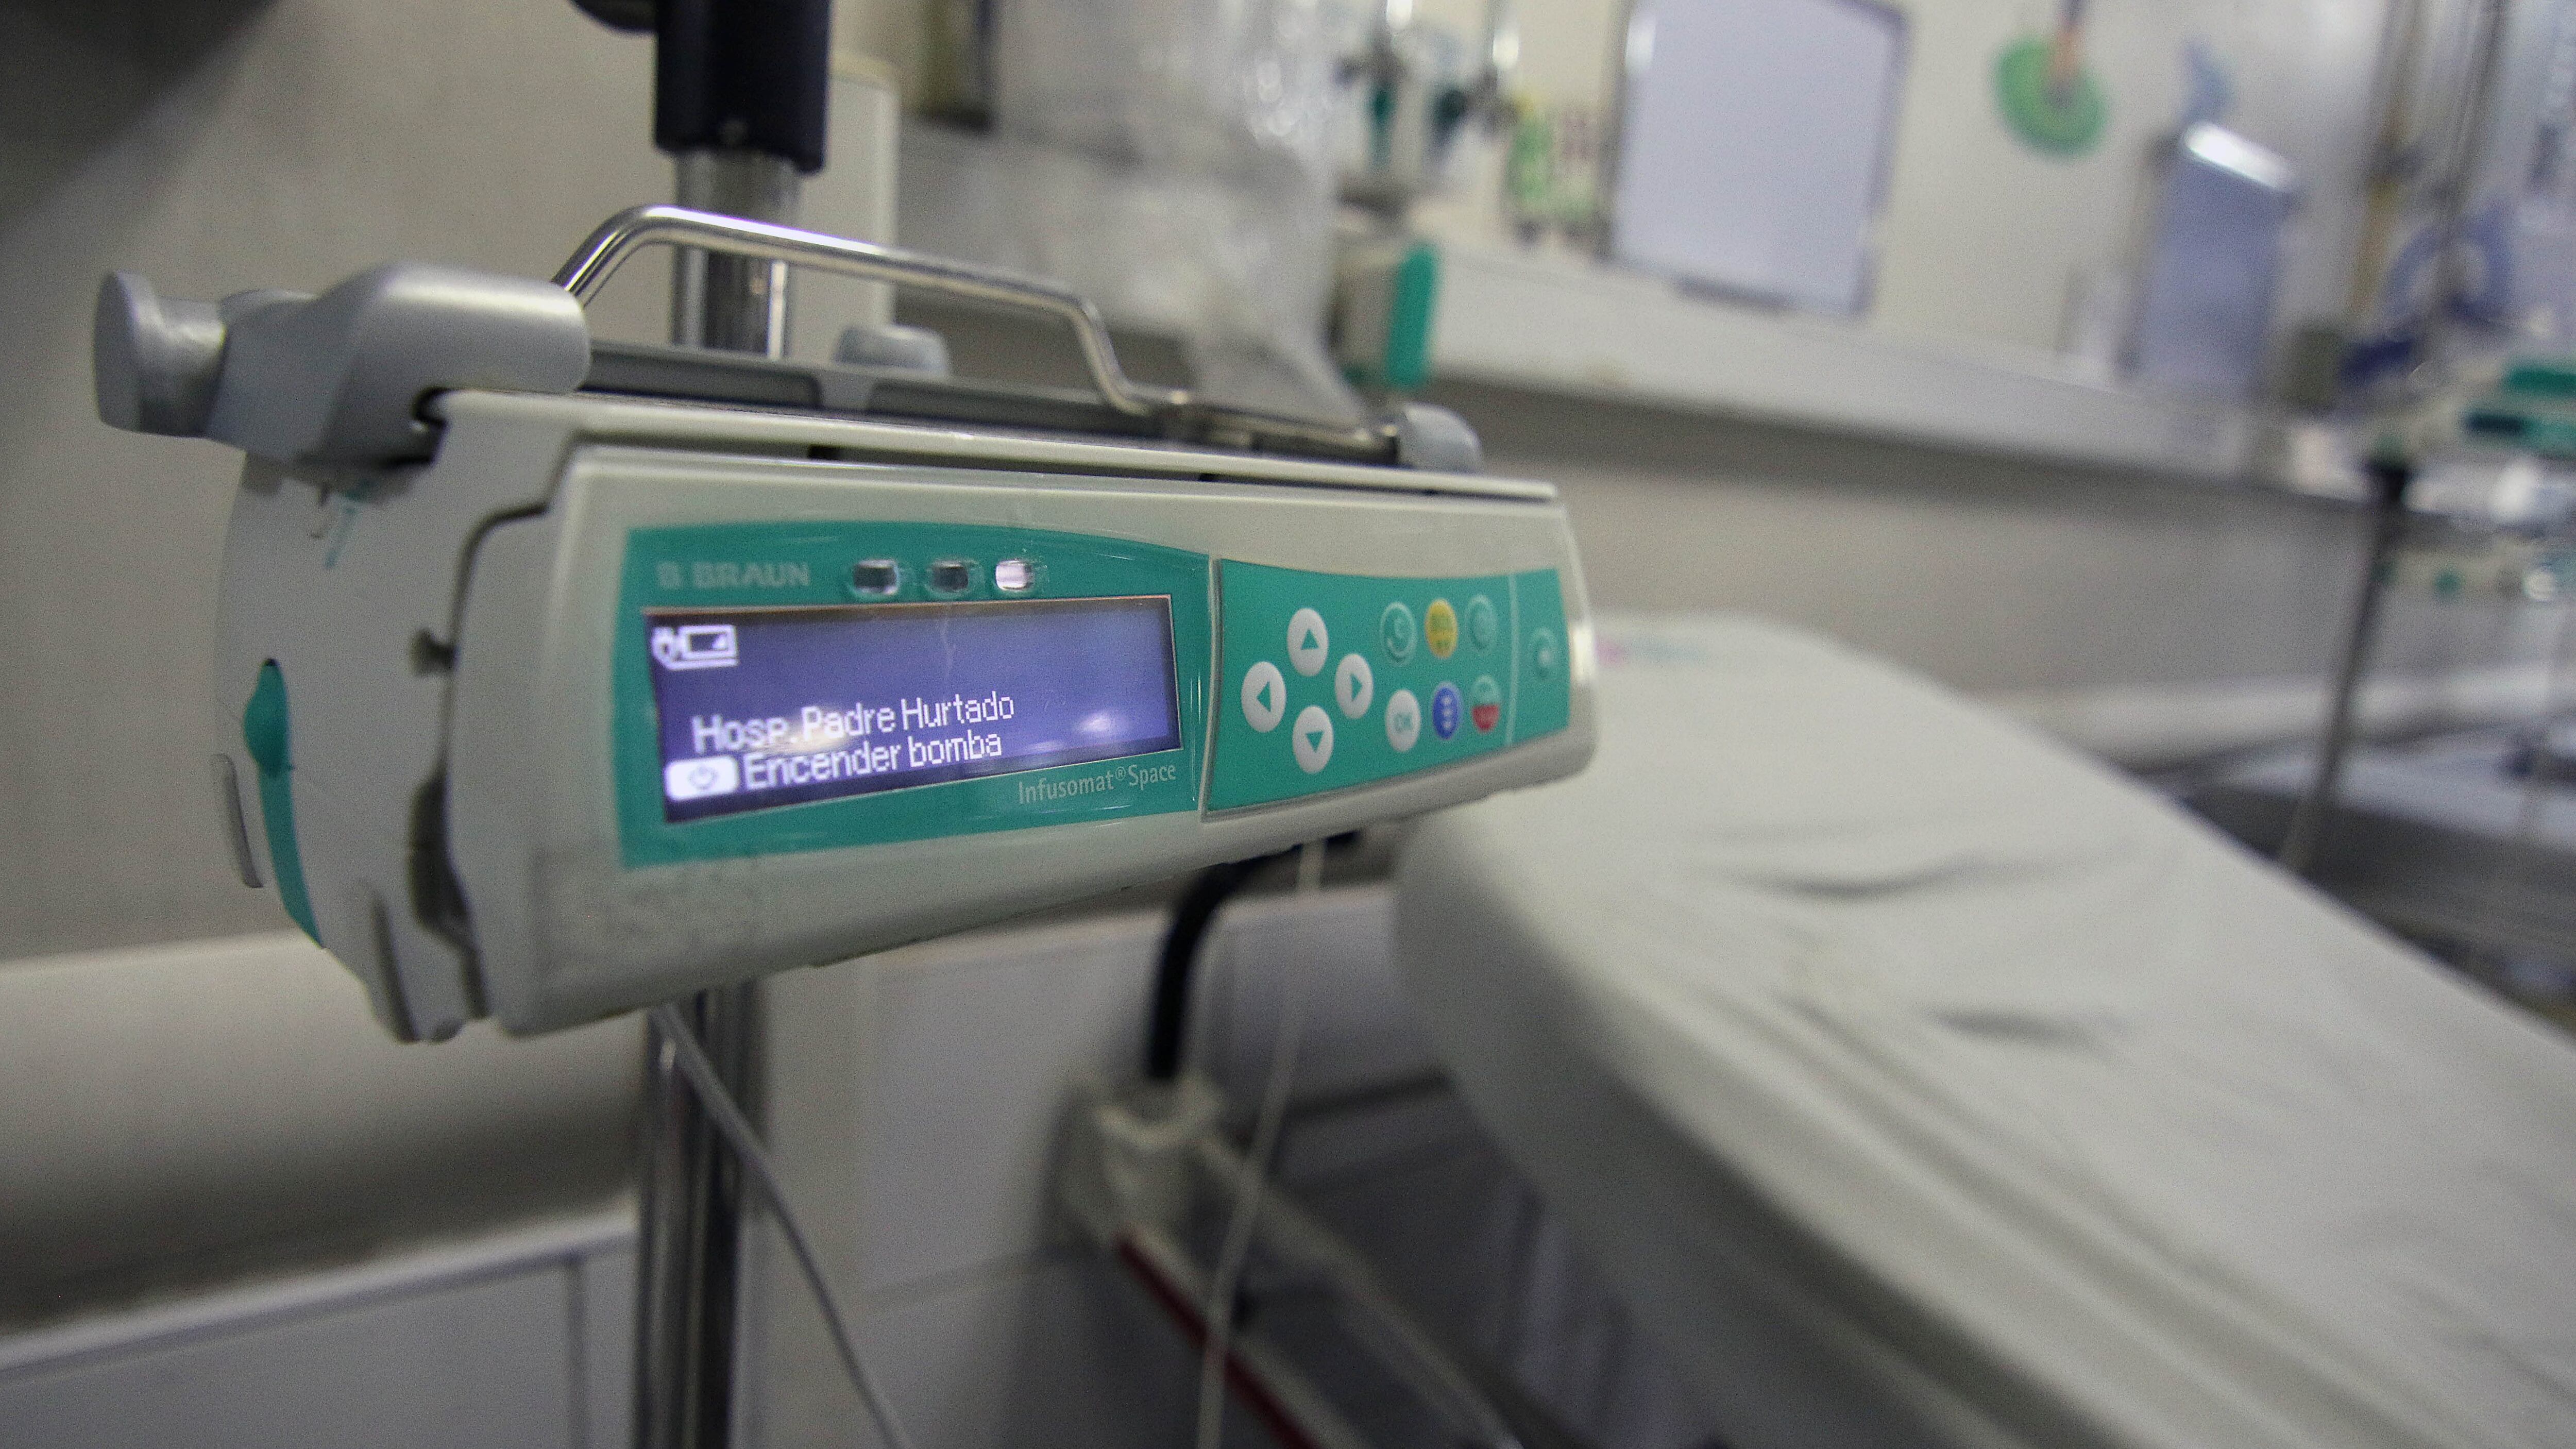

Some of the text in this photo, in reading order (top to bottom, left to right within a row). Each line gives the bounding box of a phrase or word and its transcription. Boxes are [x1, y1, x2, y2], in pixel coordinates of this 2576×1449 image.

[692, 690, 1014, 754] Hosp. Padre Hurtado
[744, 729, 1002, 790] Encender bomba
[1128, 764, 1177, 790] Space
